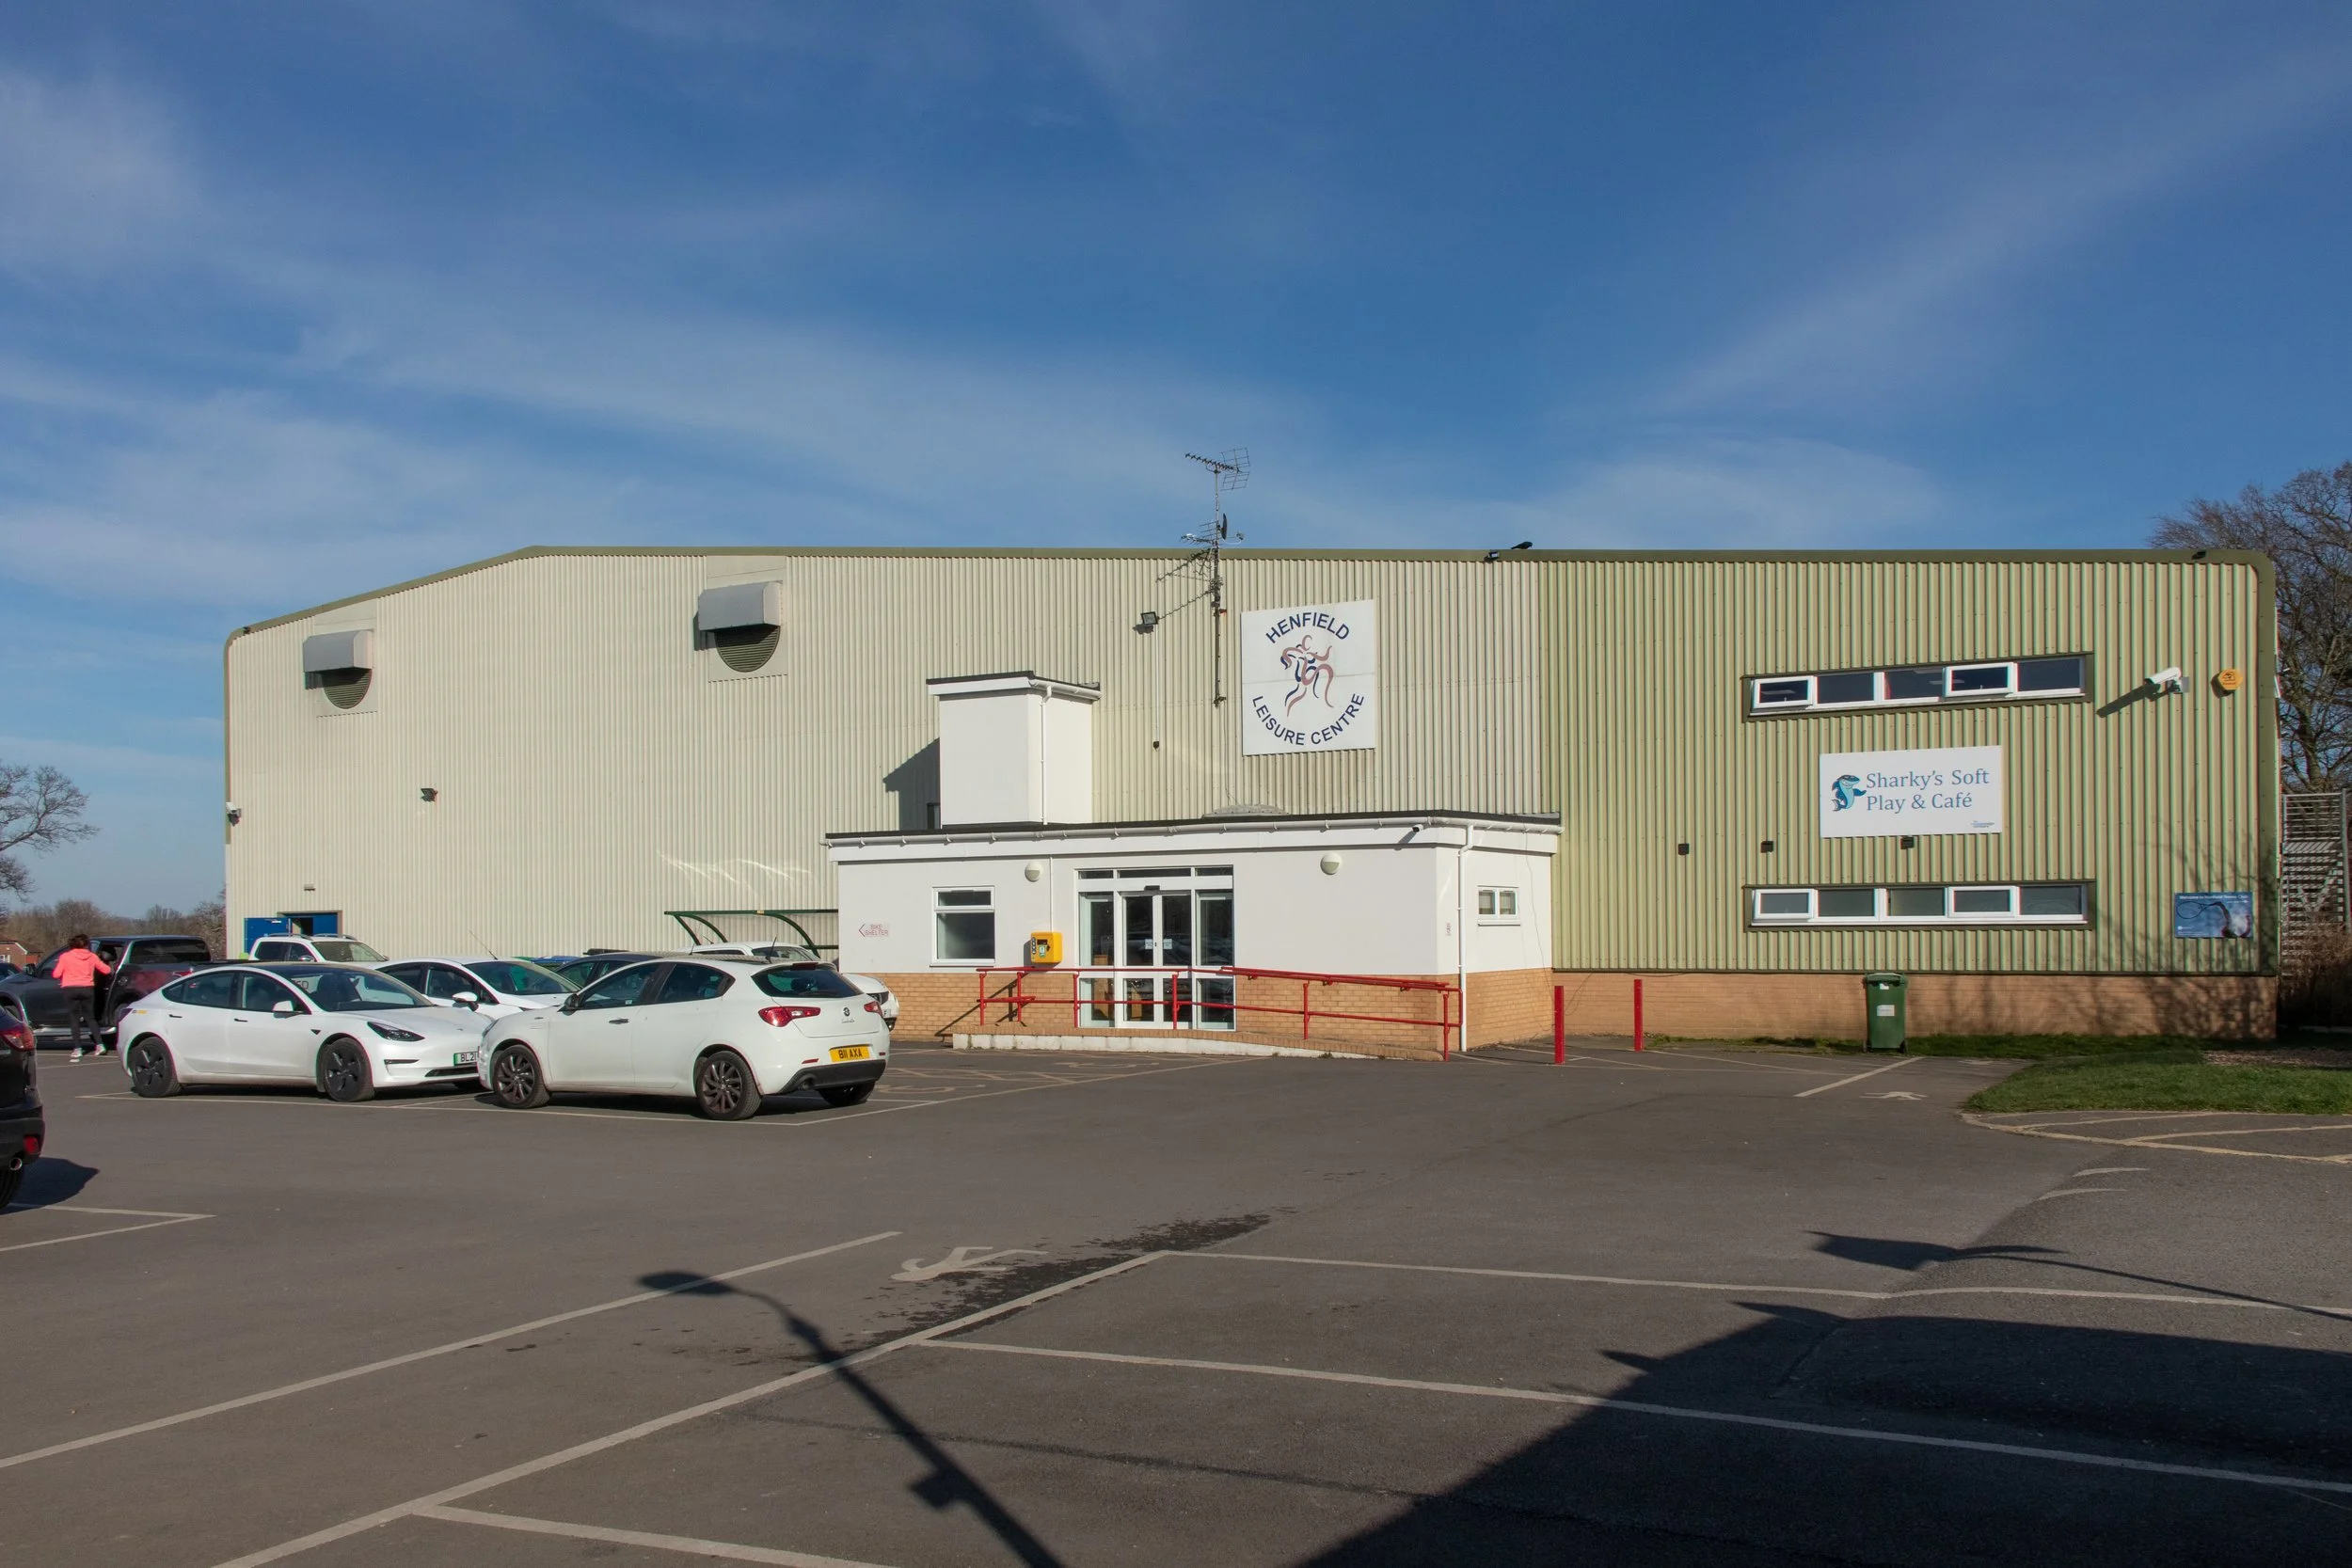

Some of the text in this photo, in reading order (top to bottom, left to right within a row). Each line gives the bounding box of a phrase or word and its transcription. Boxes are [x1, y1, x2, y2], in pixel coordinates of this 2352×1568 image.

[1265, 612, 1350, 643] HENFIELD
[1252, 693, 1365, 746] LEISURE CENTRE
[1866, 768, 1990, 791] Sharky's Soft
[1867, 792, 1973, 815] Play & Café
[850, 1048, 863, 1058] AXA
